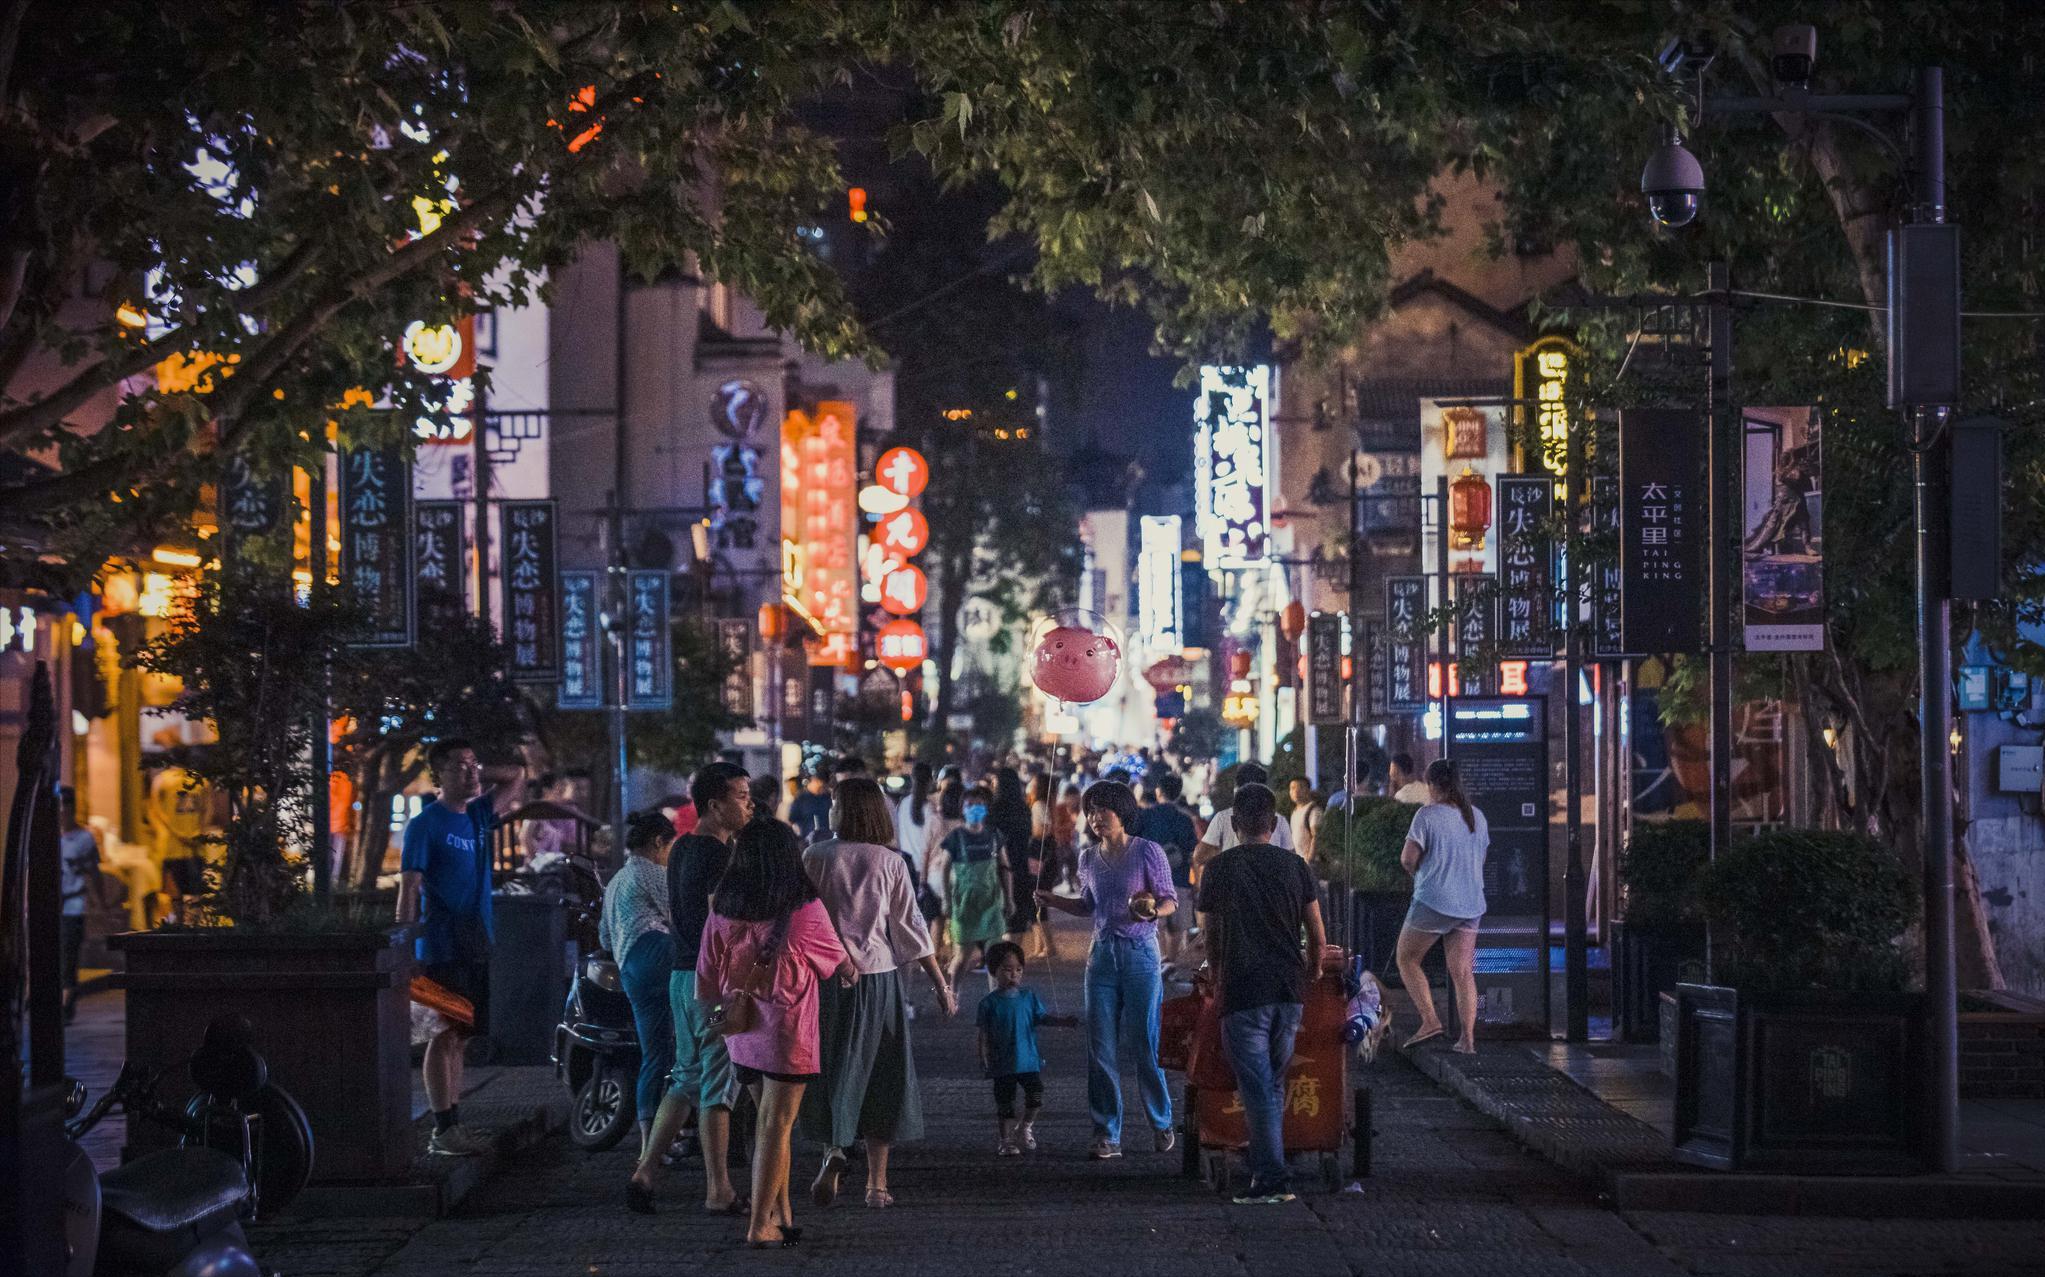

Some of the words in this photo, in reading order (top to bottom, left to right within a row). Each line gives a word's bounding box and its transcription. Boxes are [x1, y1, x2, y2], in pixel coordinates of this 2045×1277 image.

[1641, 482, 1668, 545] 太平里
[1643, 549, 1667, 557] TAI
